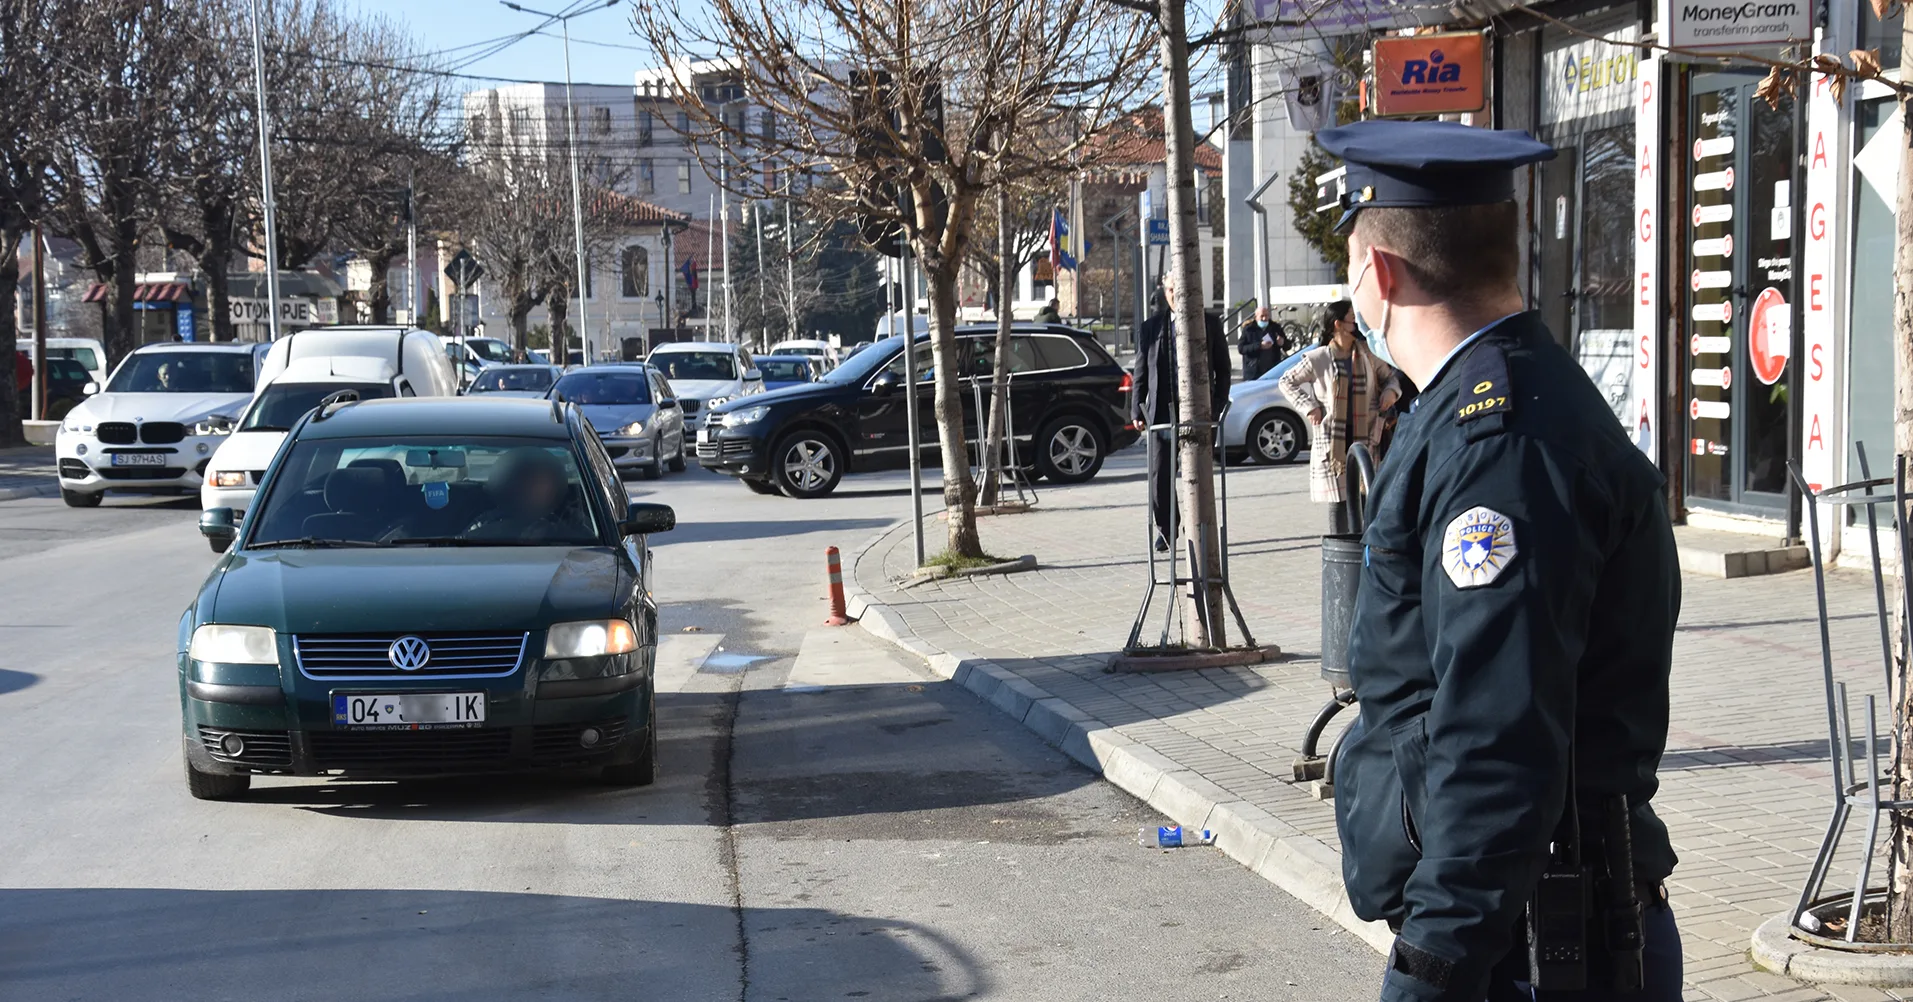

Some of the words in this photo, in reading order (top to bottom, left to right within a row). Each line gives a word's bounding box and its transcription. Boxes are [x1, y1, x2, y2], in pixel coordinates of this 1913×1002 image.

[1693, 24, 1749, 37] transferim
[1750, 22, 1789, 36] parash
[1402, 49, 1461, 85] Ria
[1639, 80, 1653, 432] PAGESA
[1459, 397, 1506, 418] 10197
[428, 490, 445, 498] FIFA
[1460, 524, 1495, 536] POLICE
[352, 698, 380, 723] 04
[455, 695, 479, 720] IK
